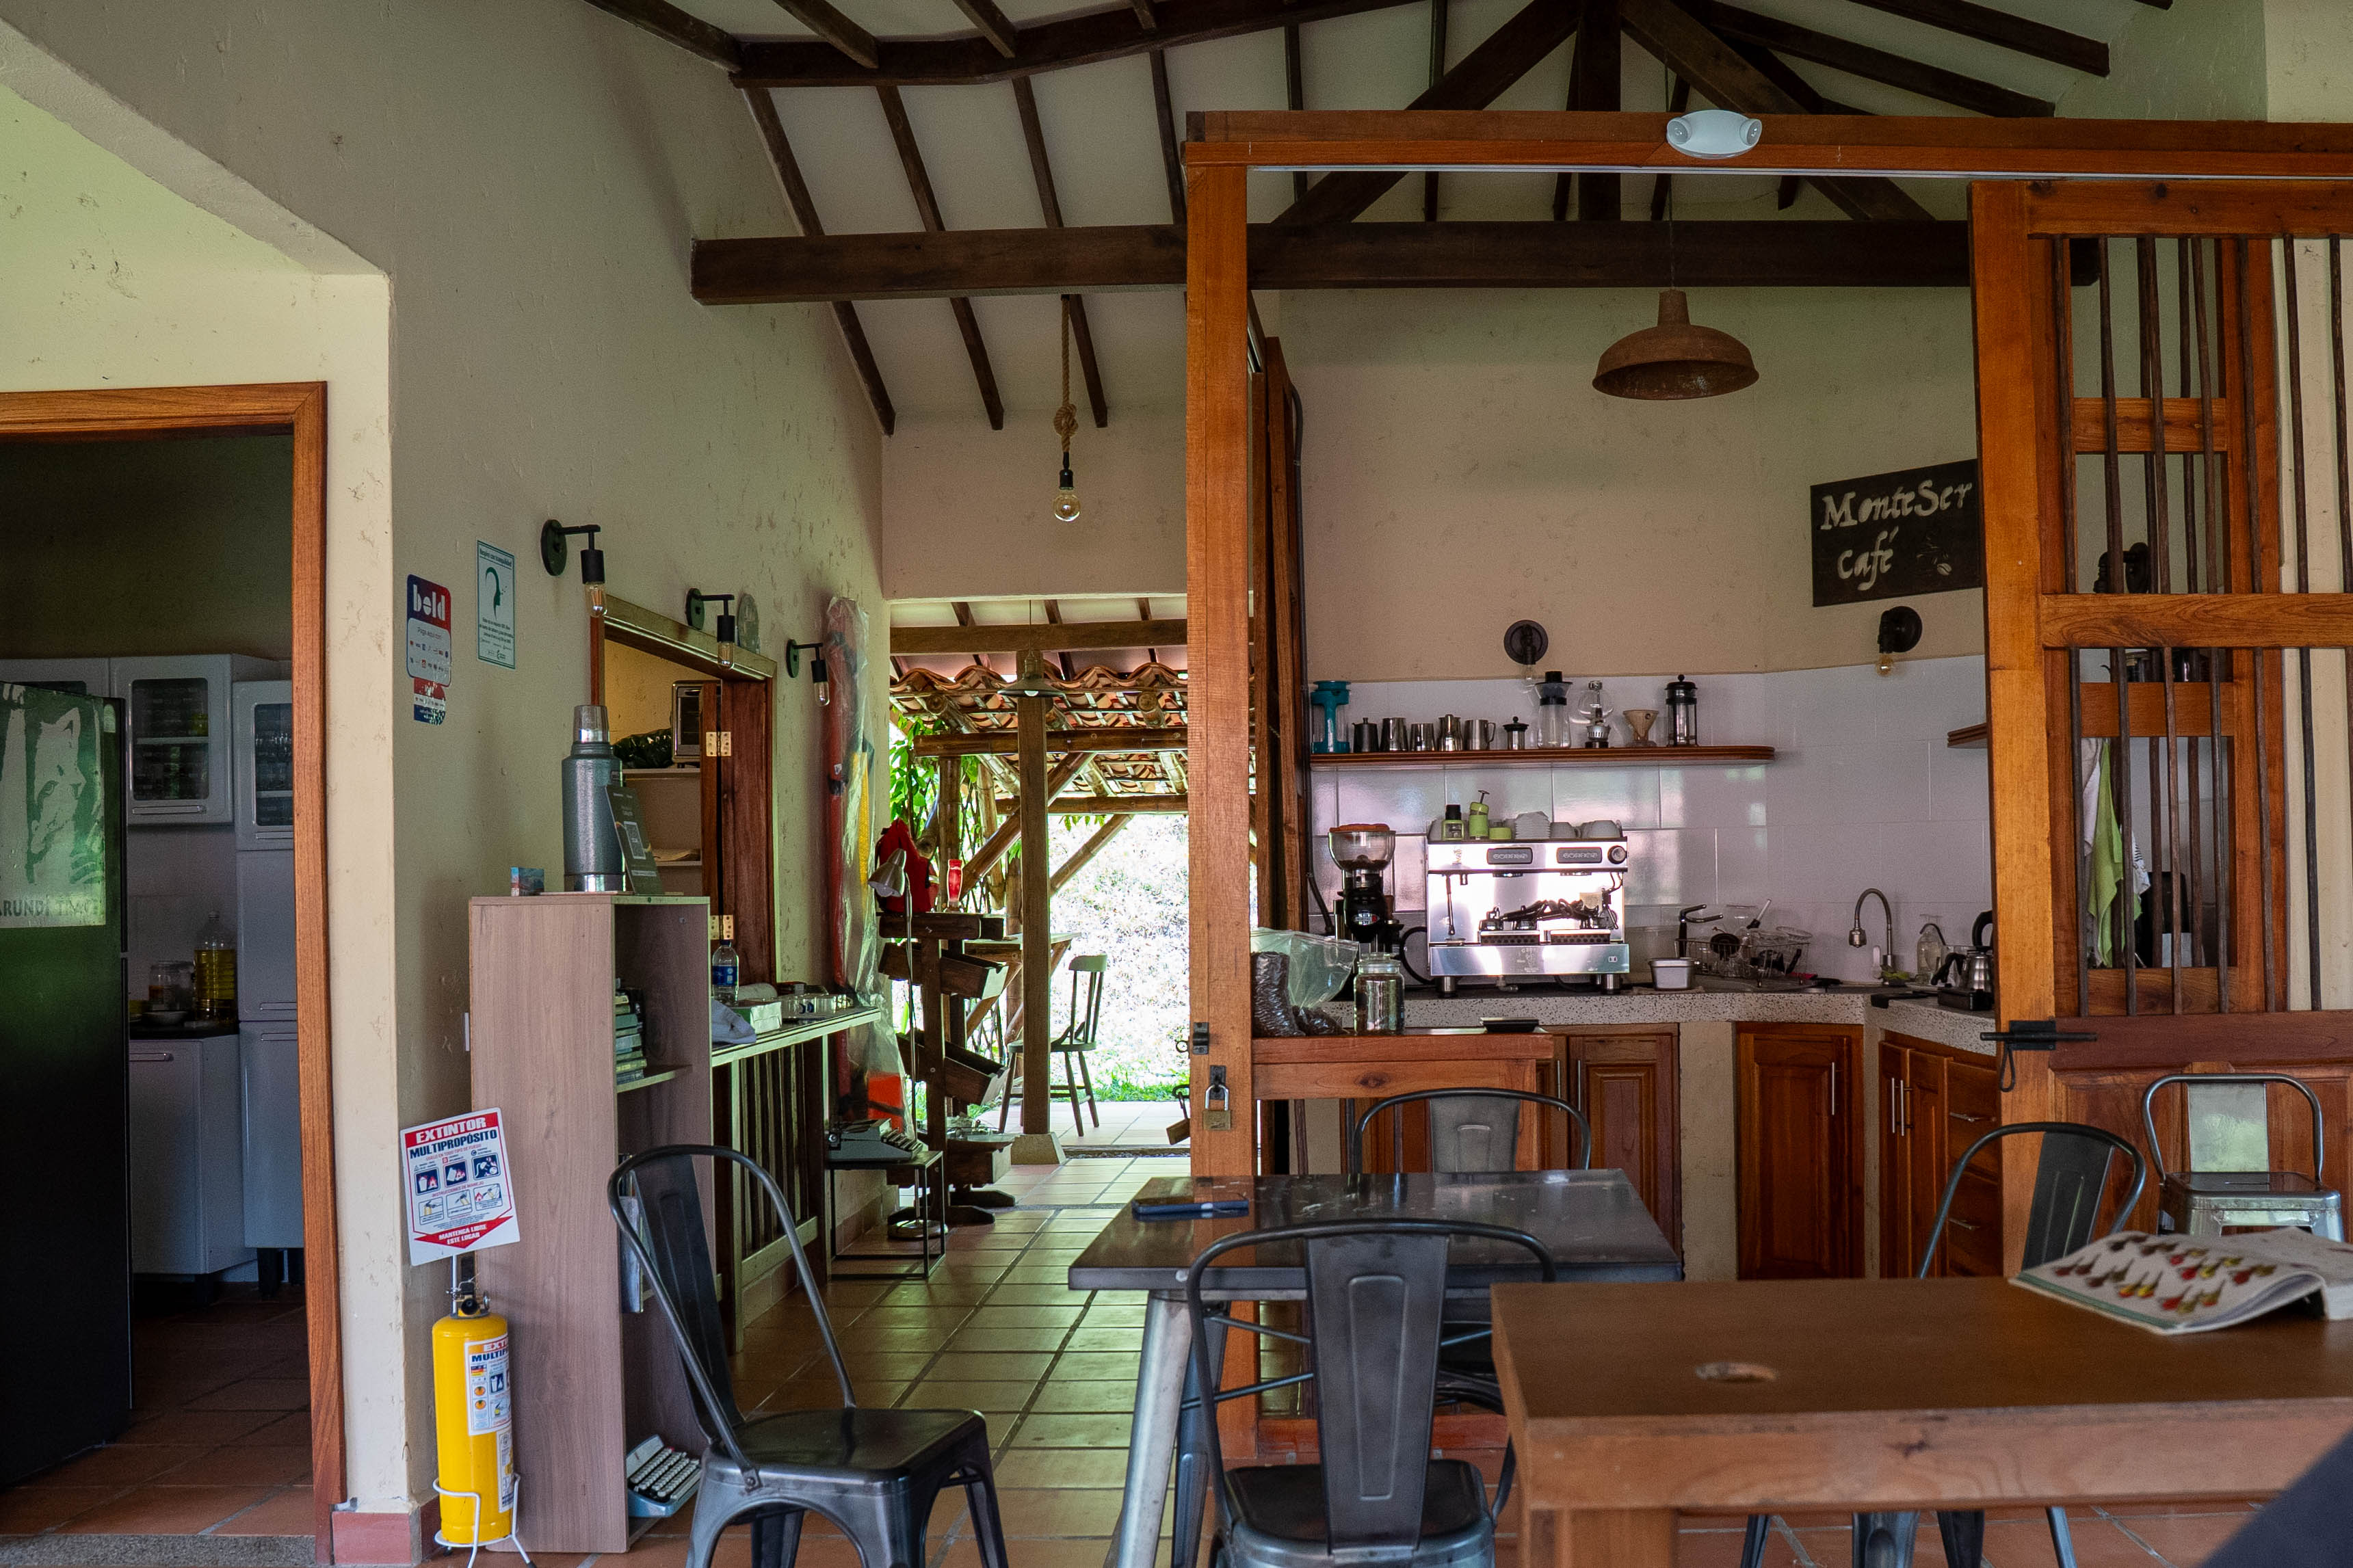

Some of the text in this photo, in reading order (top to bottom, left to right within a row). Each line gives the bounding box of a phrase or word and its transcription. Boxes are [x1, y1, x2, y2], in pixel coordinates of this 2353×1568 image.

[1819, 479, 1973, 531] MonteSer
[412, 584, 445, 621] bold
[410, 1129, 497, 1159] MULTIPROPÓSITO
[416, 1117, 486, 1144] EXTINTOR
